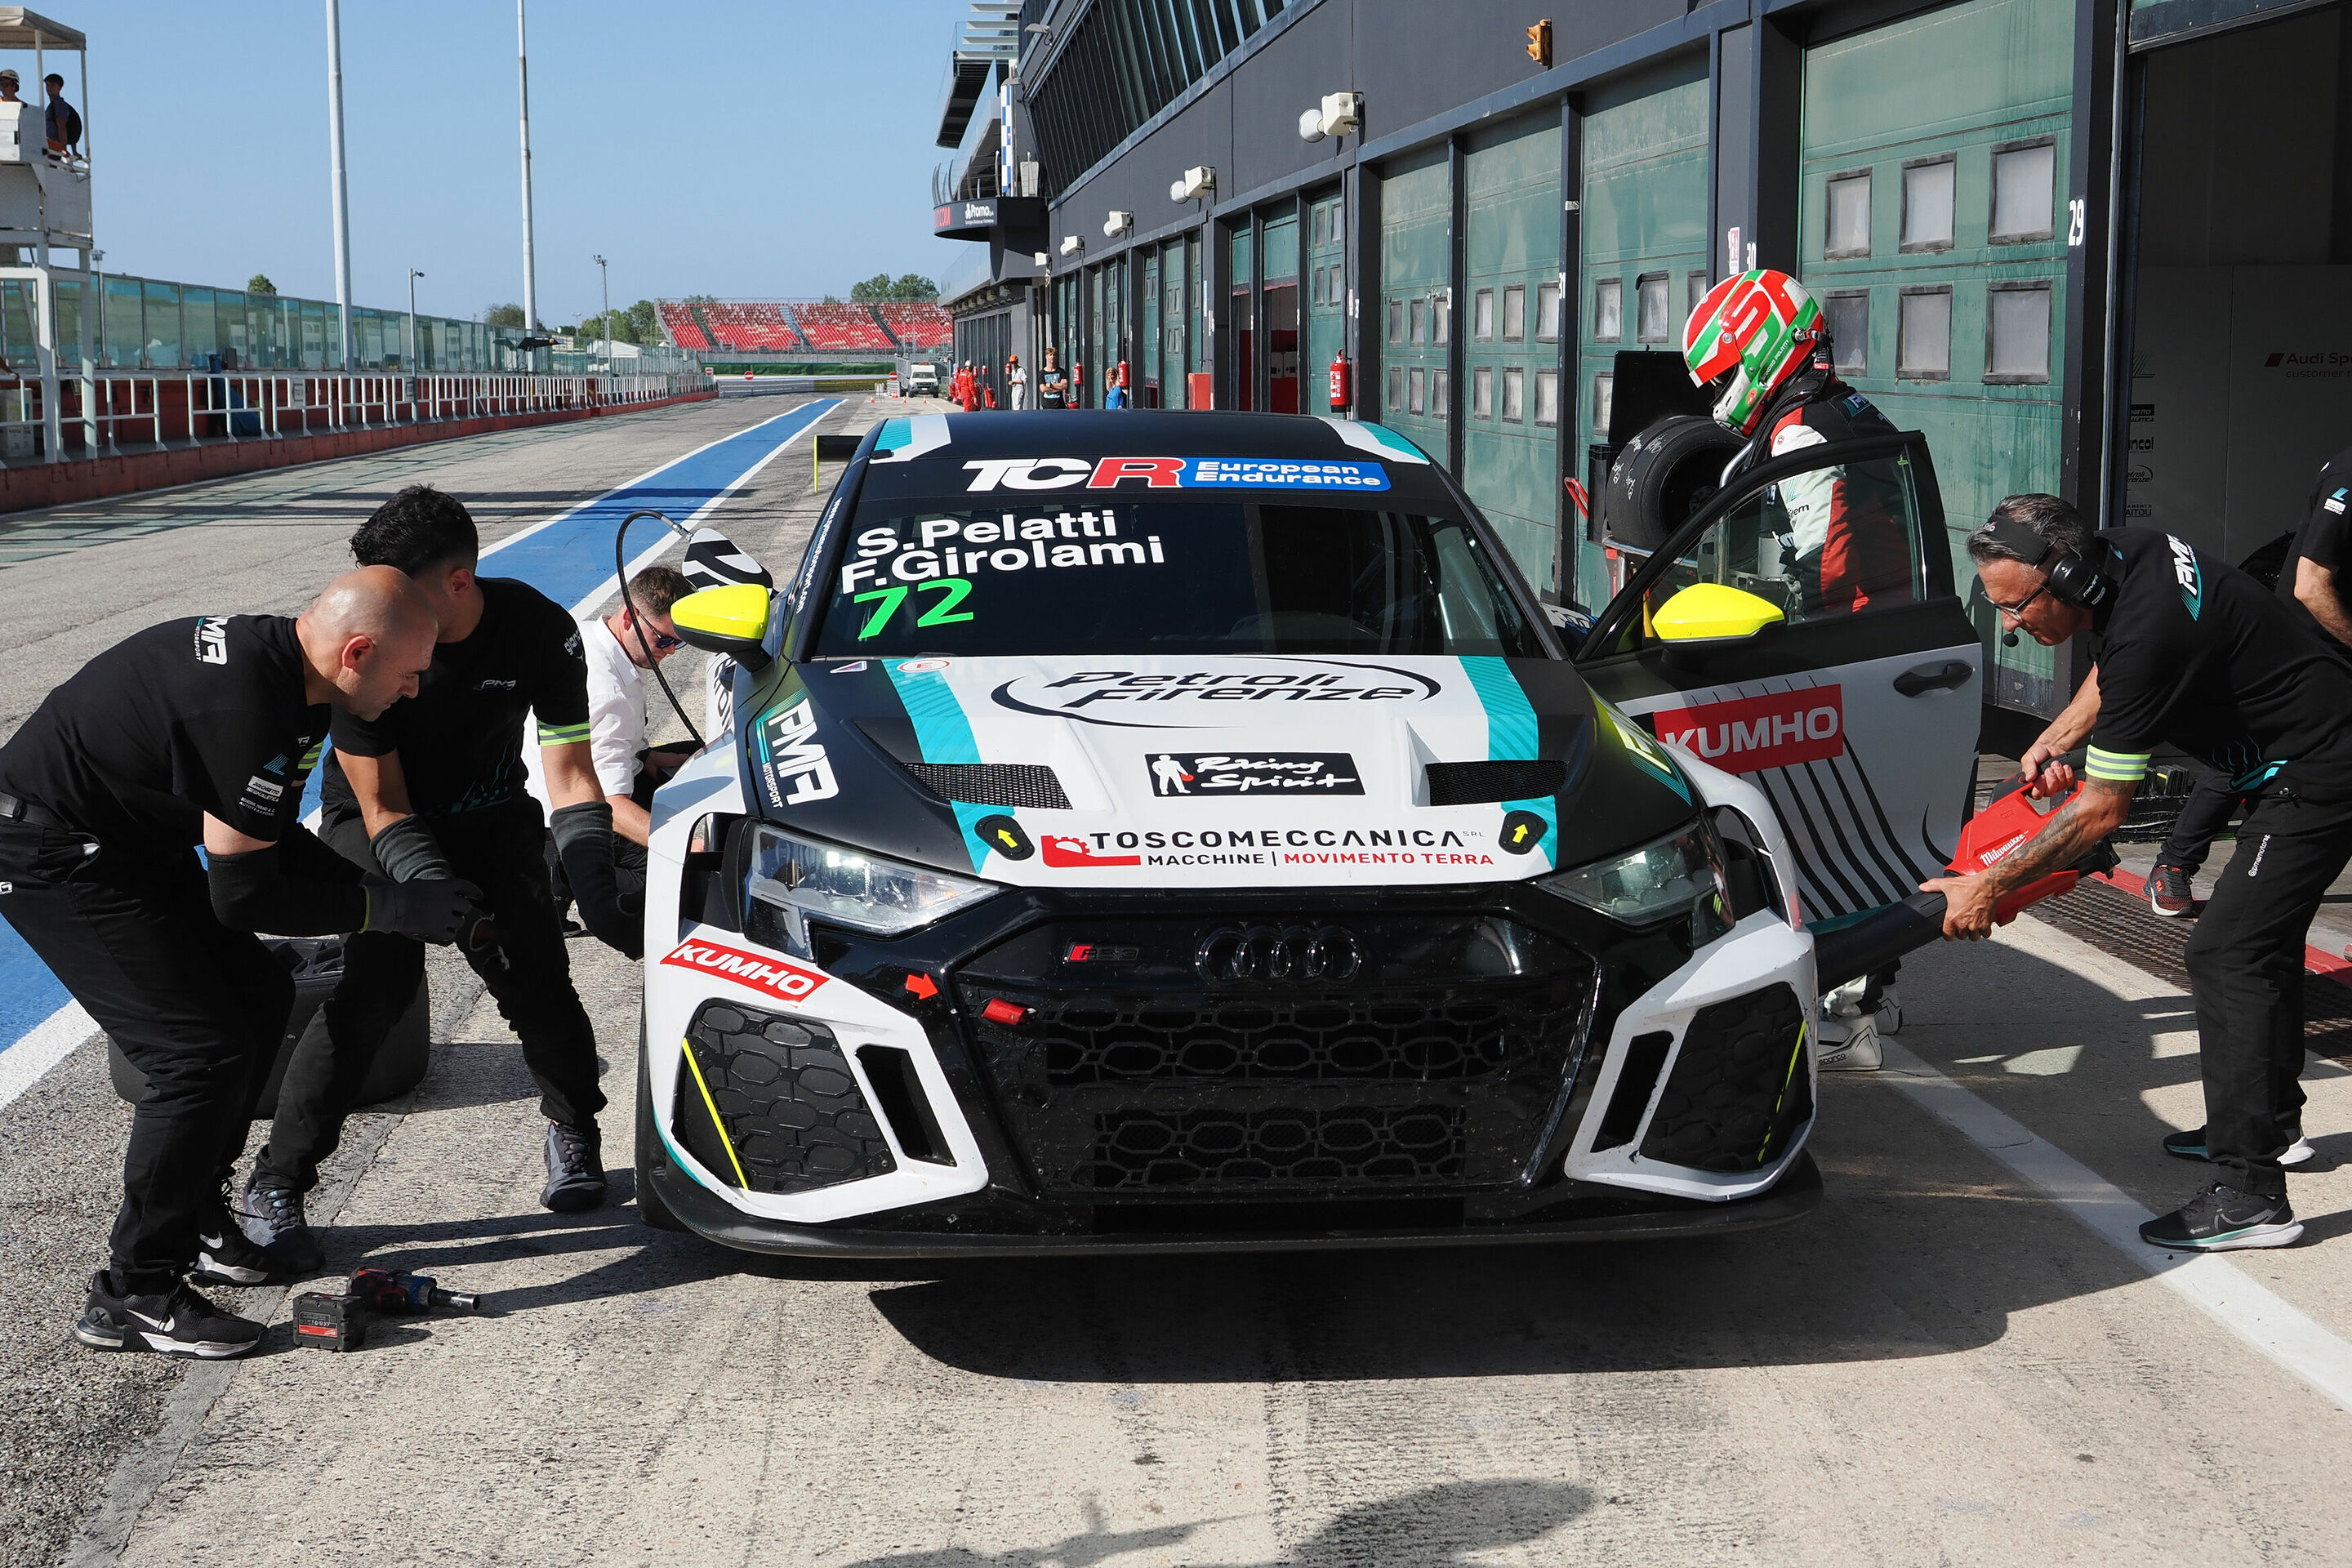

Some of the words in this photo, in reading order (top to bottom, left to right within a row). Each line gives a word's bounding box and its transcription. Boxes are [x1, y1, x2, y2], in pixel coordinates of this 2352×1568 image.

[970, 203, 990, 218] Promo
[2069, 199, 2084, 246] 29
[2287, 352, 2323, 364] Audi
[2287, 370, 2343, 378] customer
[962, 457, 1187, 491] TCR
[1197, 461, 1360, 475] European
[1194, 471, 1381, 487] Endurance
[2125, 508, 2153, 516] AITOU
[857, 510, 1117, 558] S.Pelatti
[842, 536, 1165, 595] F.Girolami
[853, 578, 973, 640] 72
[1042, 671, 1344, 688] Petroli
[1059, 685, 1416, 709] Firenze
[1664, 706, 1838, 760] KUMHO
[1194, 756, 1325, 774] Racing
[762, 761, 783, 808] MOTORSPORT
[1200, 773, 1356, 792] Spirit
[1089, 830, 1464, 850] TOSCOMECCANICA
[1147, 853, 1265, 866] MACCHINE
[1284, 853, 1415, 864] MOVIMENTO
[1421, 853, 1494, 865] TERRA
[1980, 834, 2025, 867] Milwaukee
[670, 944, 814, 996] KUMHO
